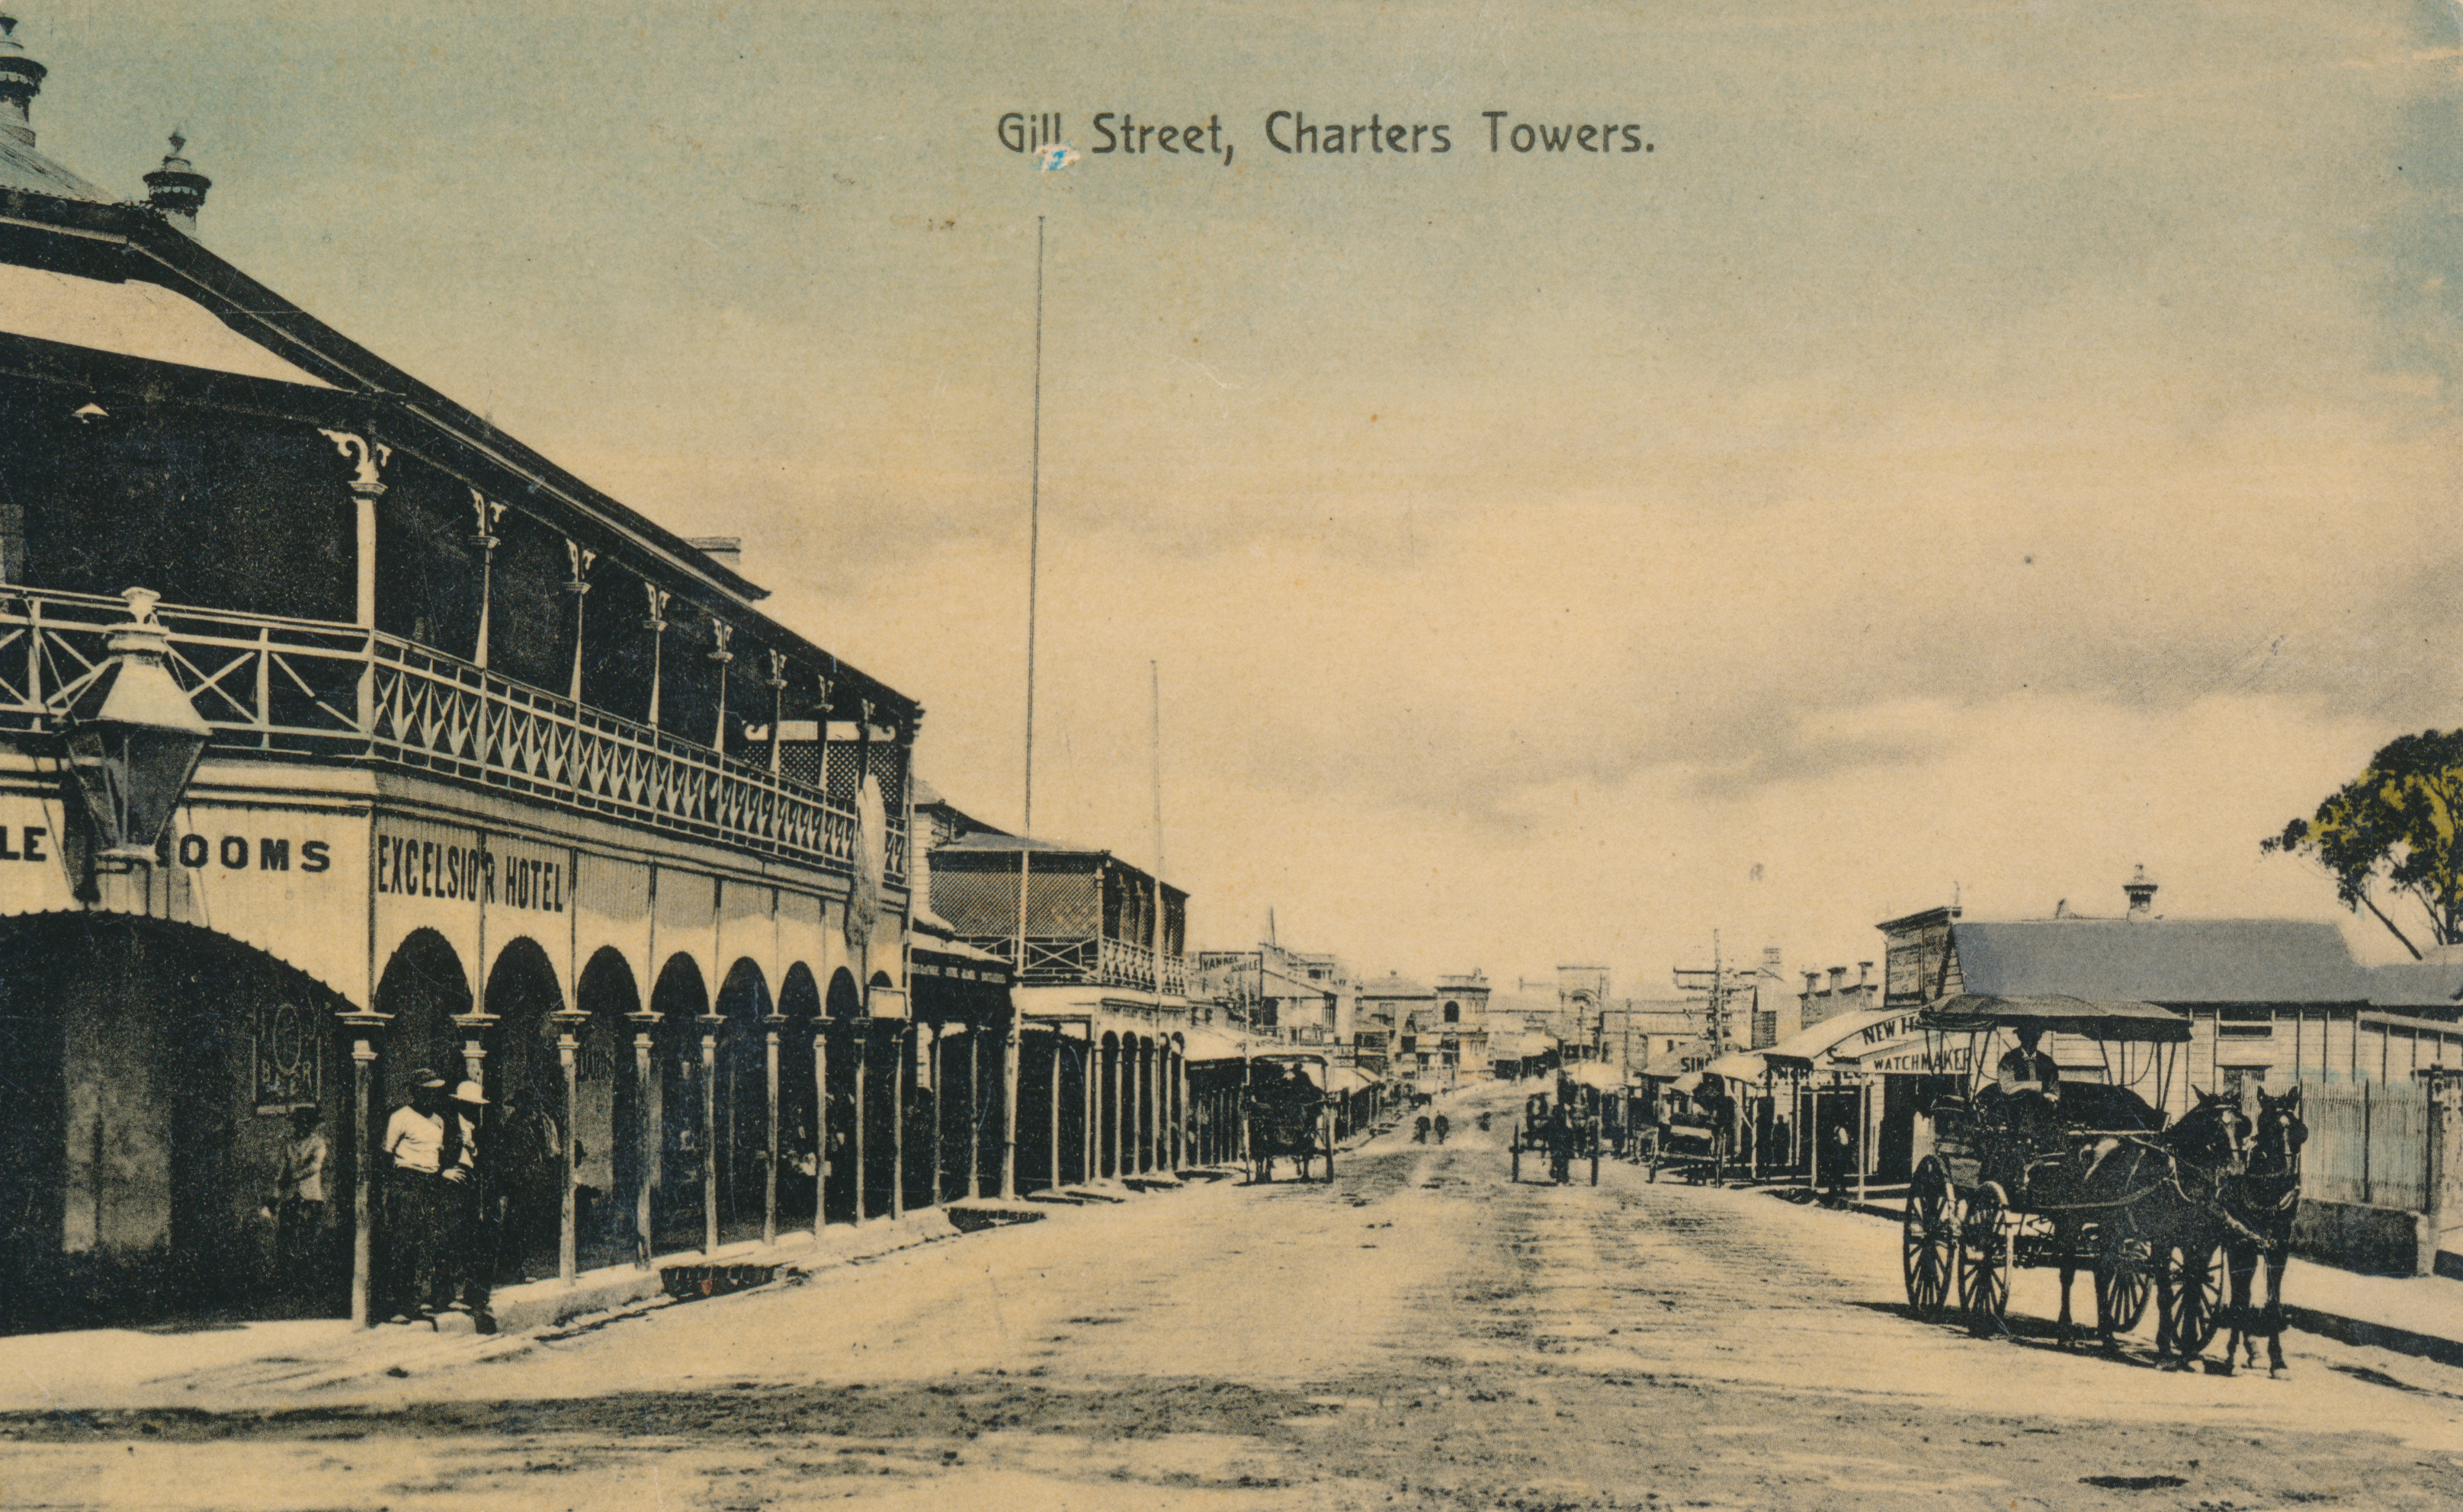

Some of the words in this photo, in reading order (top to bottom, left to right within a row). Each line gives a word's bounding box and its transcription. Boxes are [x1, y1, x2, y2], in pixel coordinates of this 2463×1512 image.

[378, 834, 495, 905] EXCELSIOR
[505, 855, 564, 914] HOTEL
[1861, 1020, 1896, 1046] NEW
